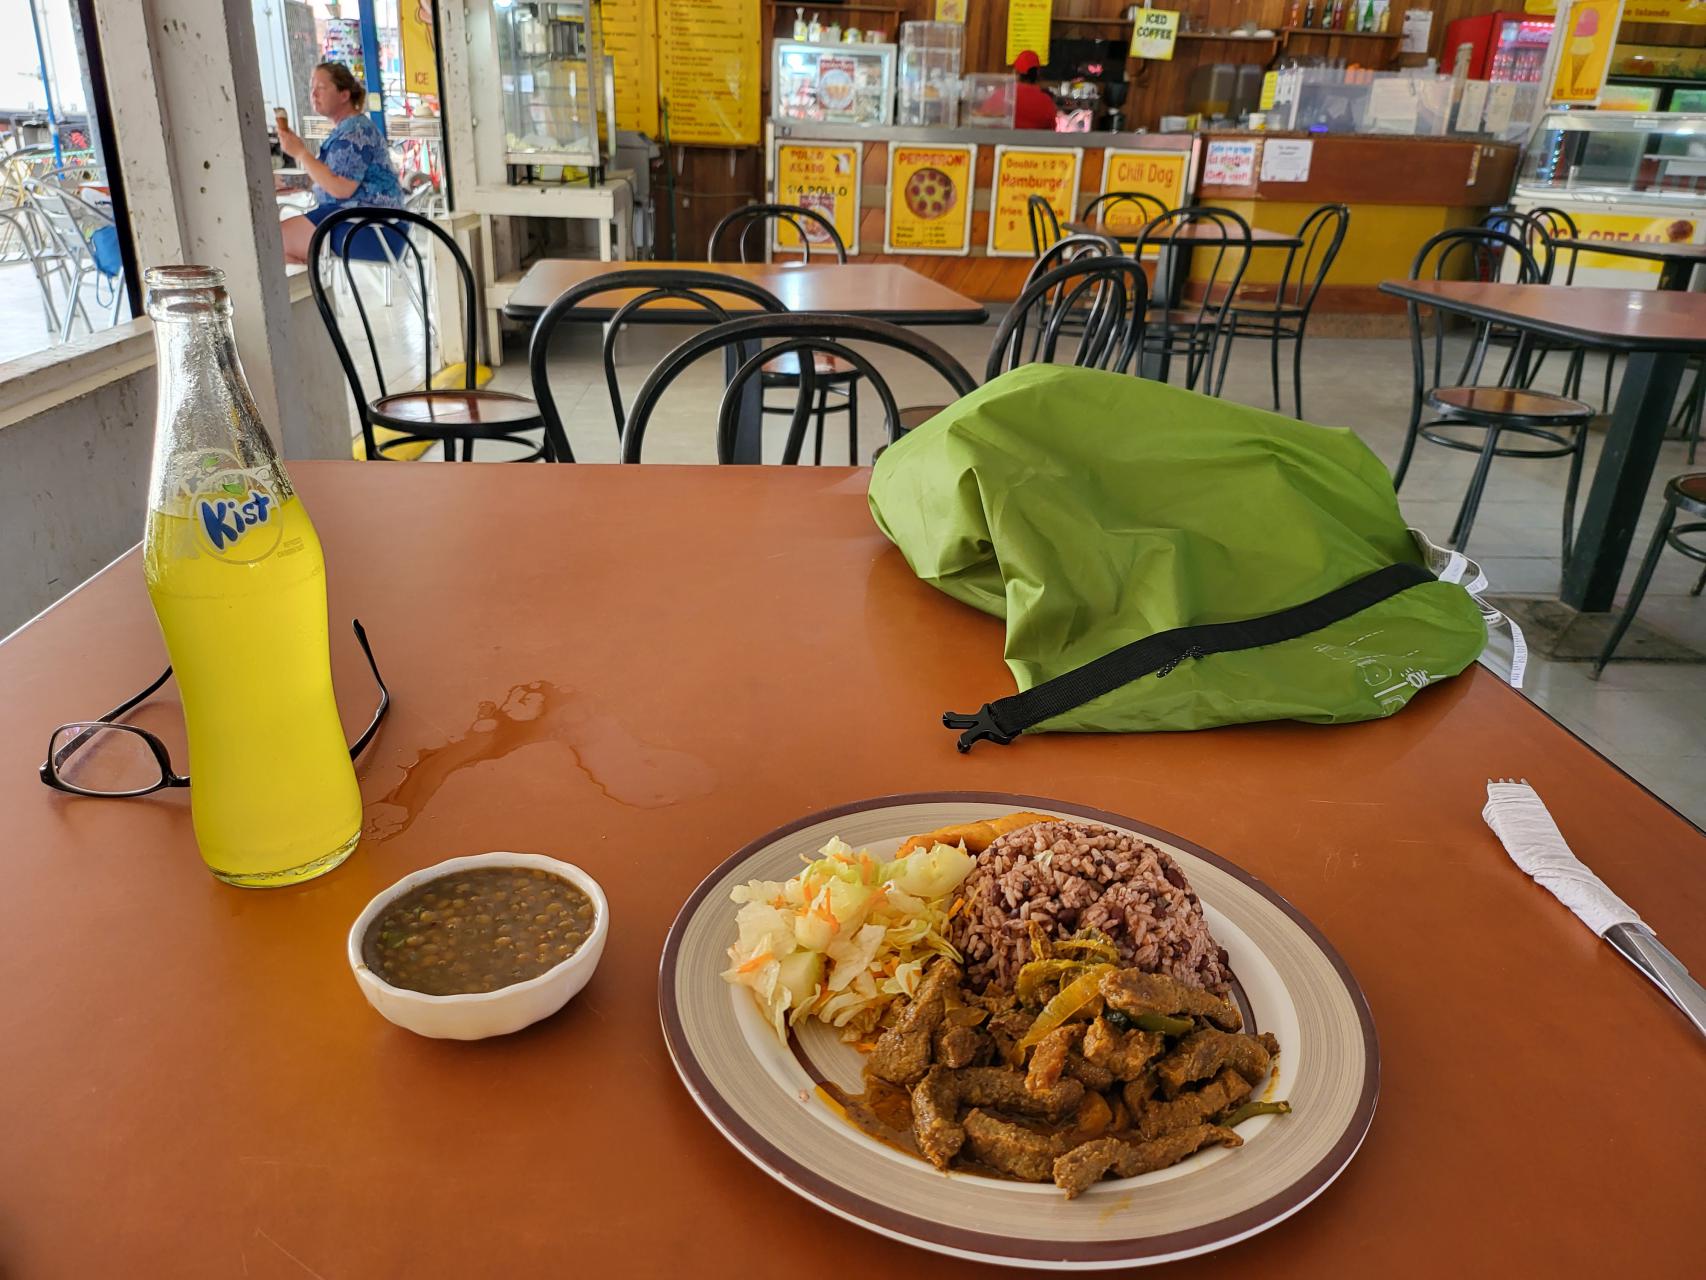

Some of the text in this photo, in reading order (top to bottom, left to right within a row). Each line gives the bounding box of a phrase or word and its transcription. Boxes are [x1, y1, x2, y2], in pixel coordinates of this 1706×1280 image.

[1145, 13, 1168, 26] ICED
[1136, 26, 1173, 41] COFFEE
[414, 71, 429, 86] ICE
[1118, 162, 1174, 188] Chili Dog
[808, 185, 848, 198] POLLO
[200, 491, 270, 551] Kist
